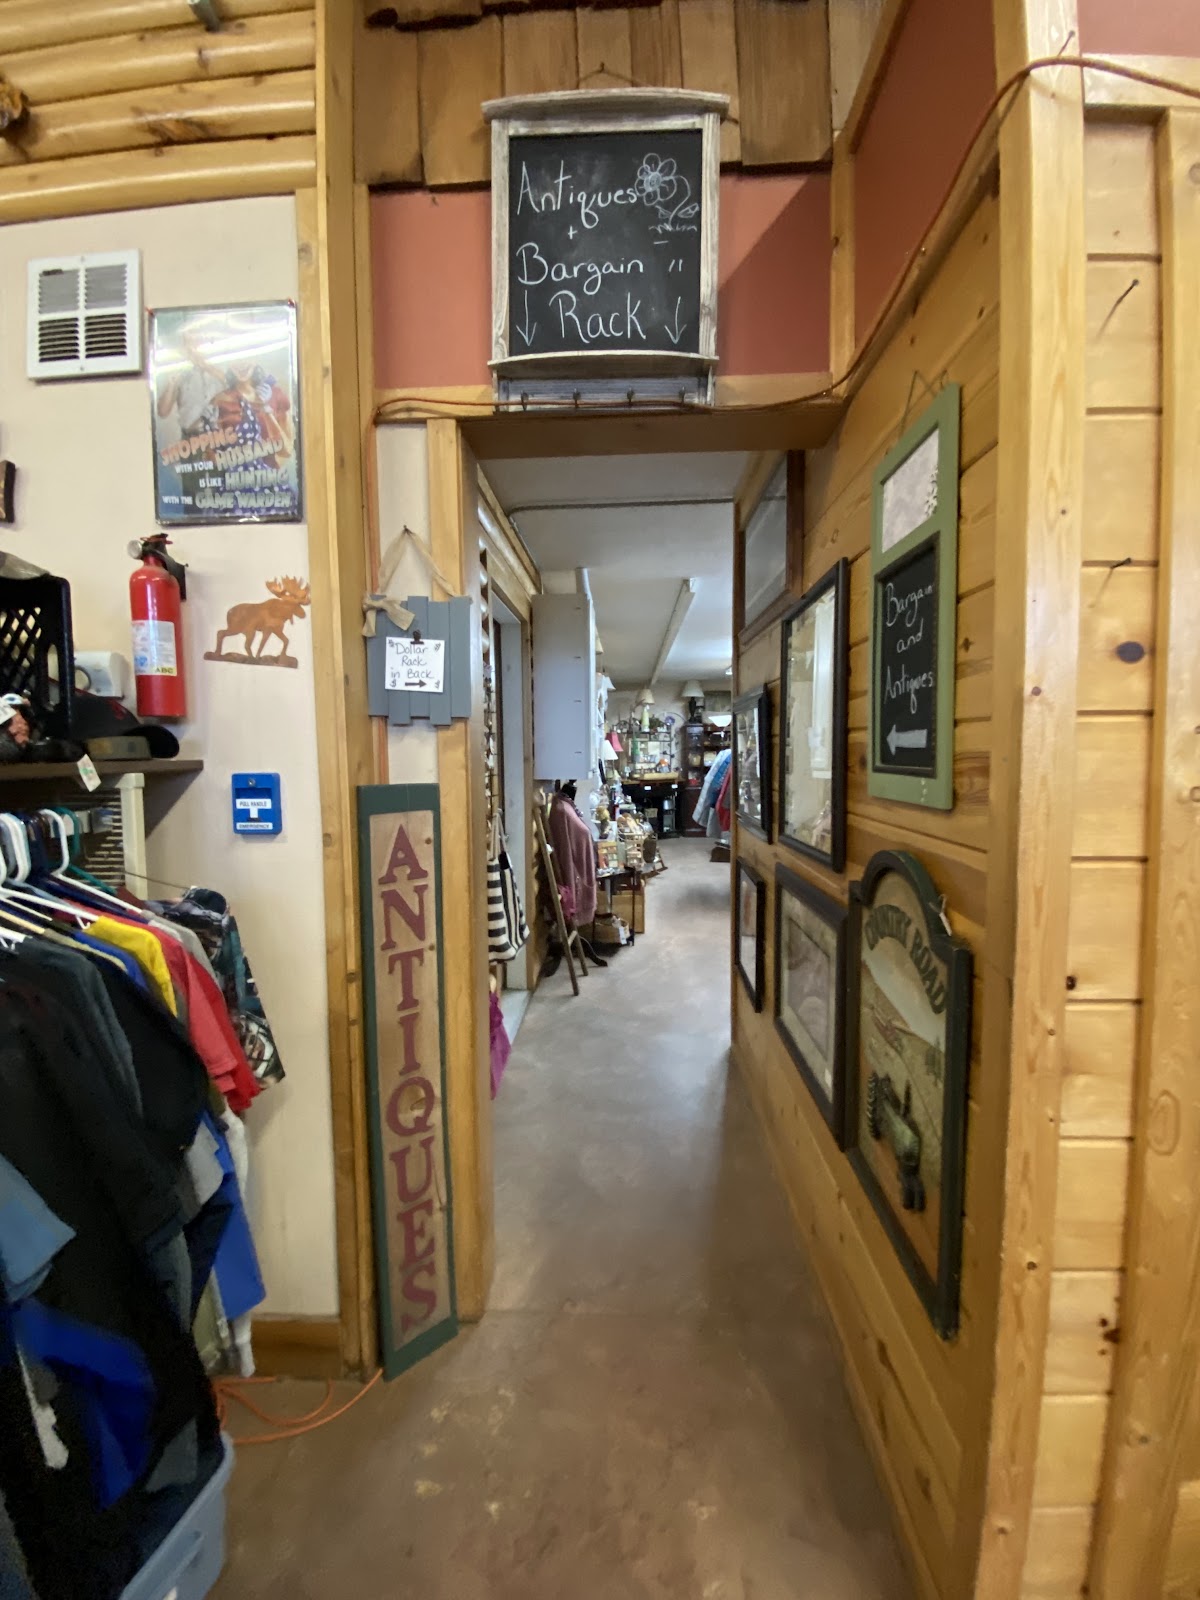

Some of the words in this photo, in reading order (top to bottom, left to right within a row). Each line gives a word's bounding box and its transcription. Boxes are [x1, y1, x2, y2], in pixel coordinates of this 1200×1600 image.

[517, 160, 638, 229] Antiques
[516, 242, 644, 295] Bargain
[549, 290, 646, 344] Rack
[160, 426, 239, 466] SHOPPING
[175, 463, 192, 474] WITH
[193, 460, 214, 471] YOUR
[215, 438, 283, 471] HUSBAND
[199, 478, 206, 488] IS
[206, 477, 222, 488] LIKE
[225, 467, 290, 490] HUNTING
[162, 495, 179, 505] WITH
[180, 495, 193, 505] THE
[195, 491, 234, 509] GAME
[235, 490, 291, 509] WARDEN
[395, 642, 428, 655] Dollar
[896, 617, 924, 653] and
[390, 666, 401, 679] in
[407, 669, 434, 679] Back
[401, 655, 427, 666] Rack
[884, 663, 934, 714] Antiques
[910, 927, 945, 1015] ROAD
[378, 824, 437, 1334] ANTIQUES
